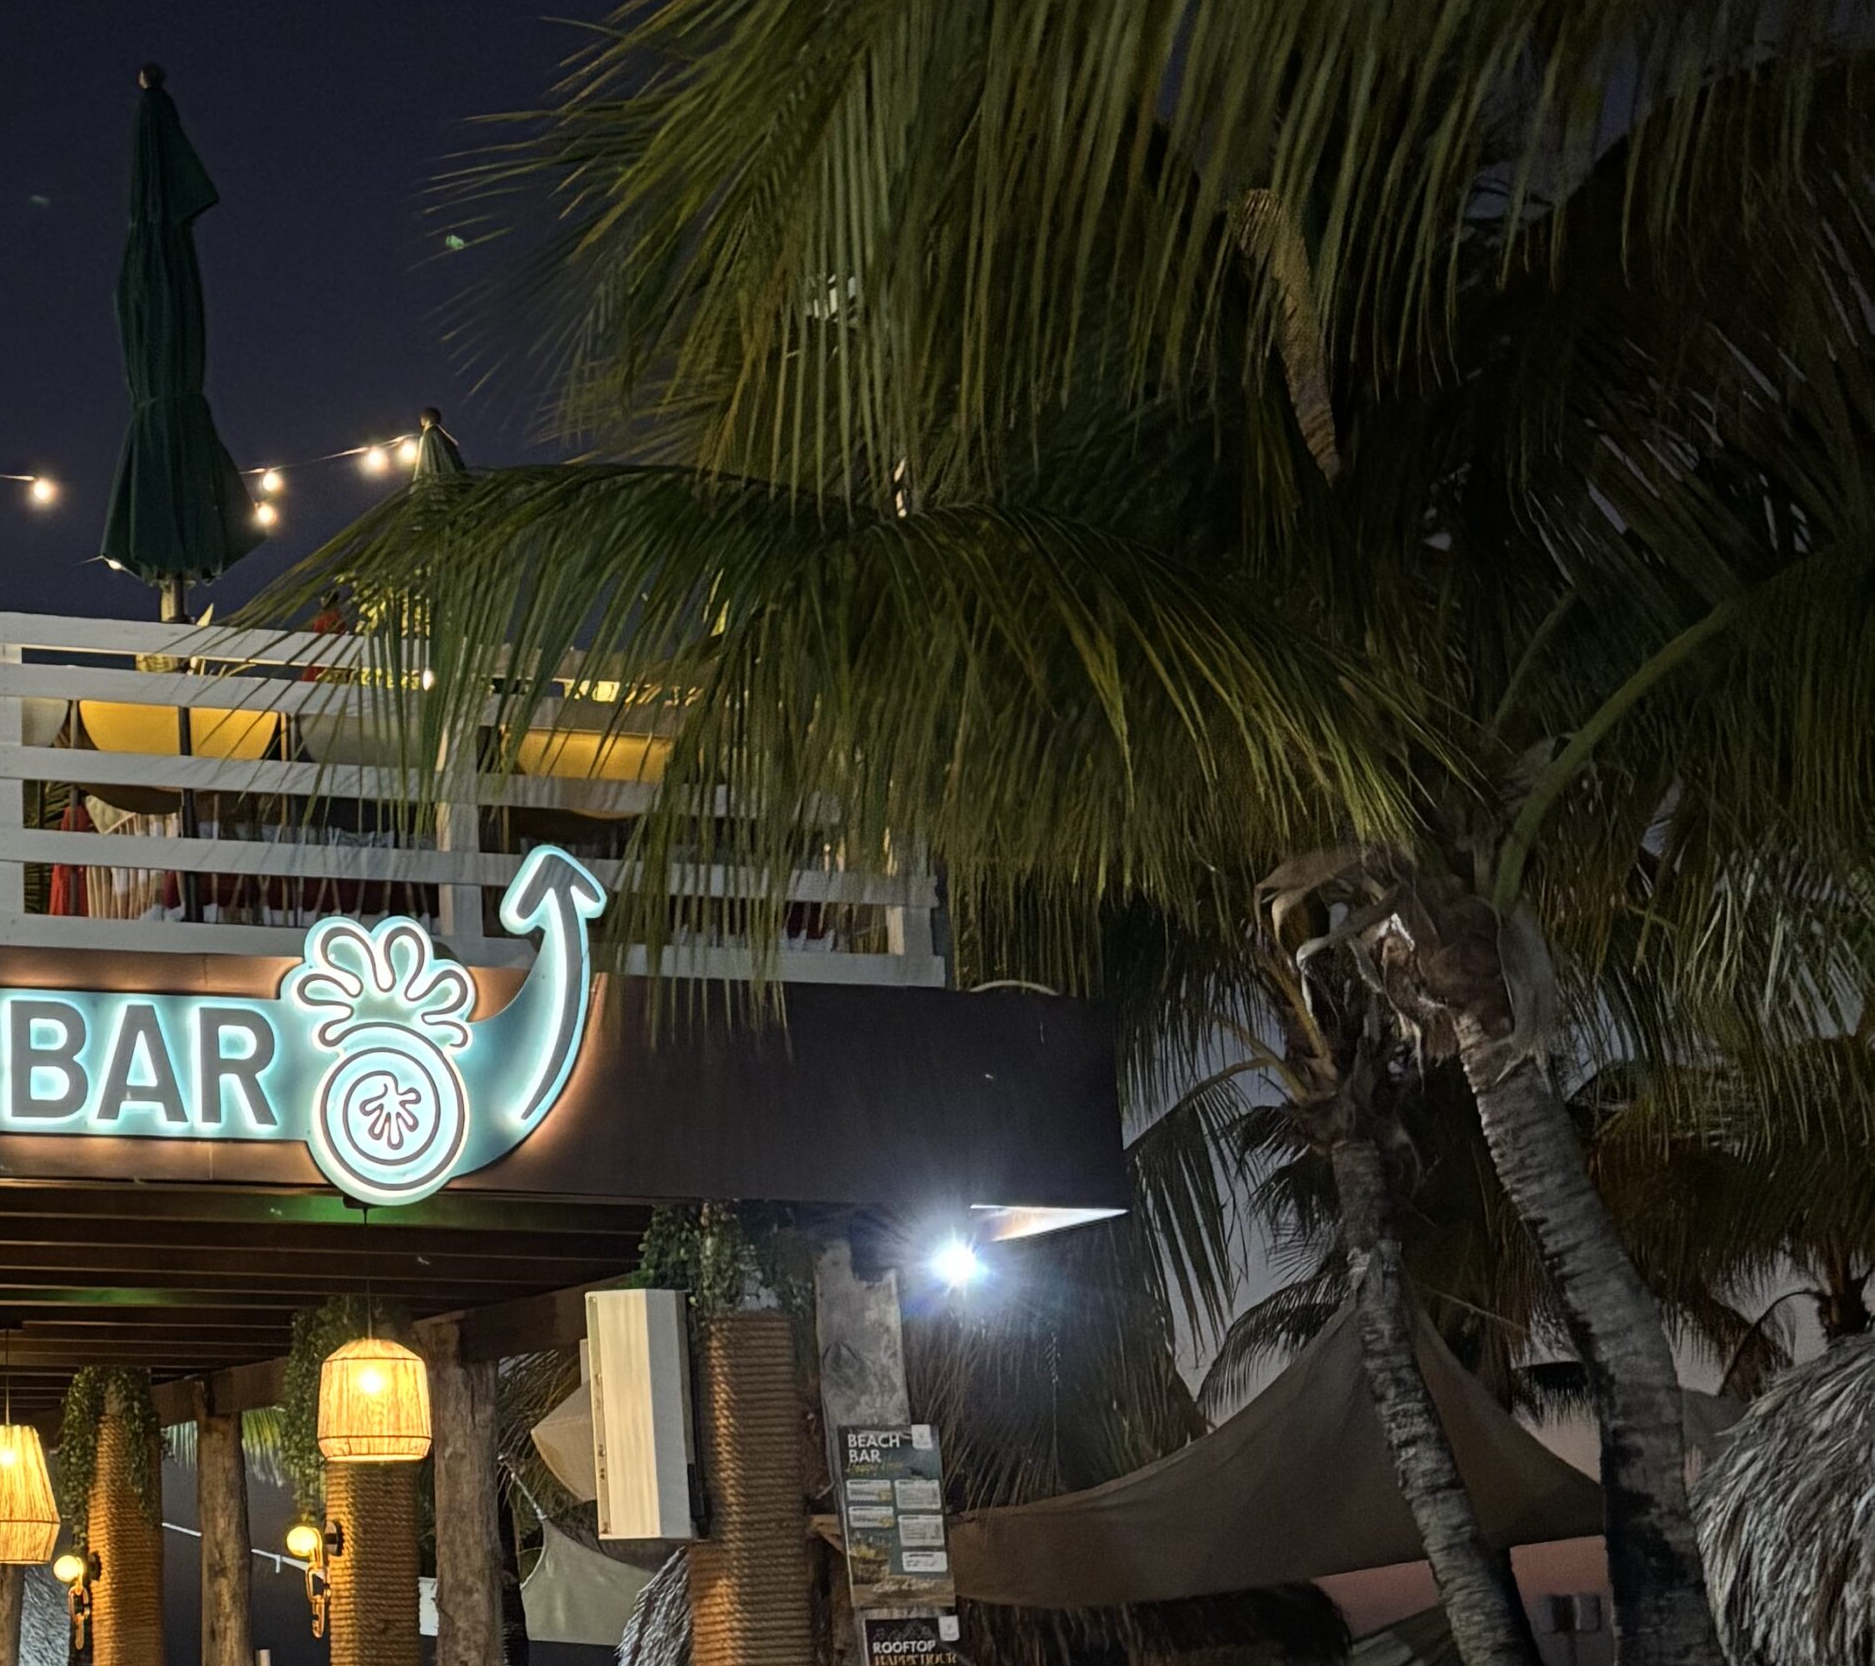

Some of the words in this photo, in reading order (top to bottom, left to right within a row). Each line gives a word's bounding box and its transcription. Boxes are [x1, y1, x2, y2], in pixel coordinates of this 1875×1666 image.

[11, 997, 278, 1126] BAR
[847, 1434, 900, 1448] BEACH
[849, 1449, 882, 1463] BAR
[873, 1640, 936, 1654] ROOFTOP
